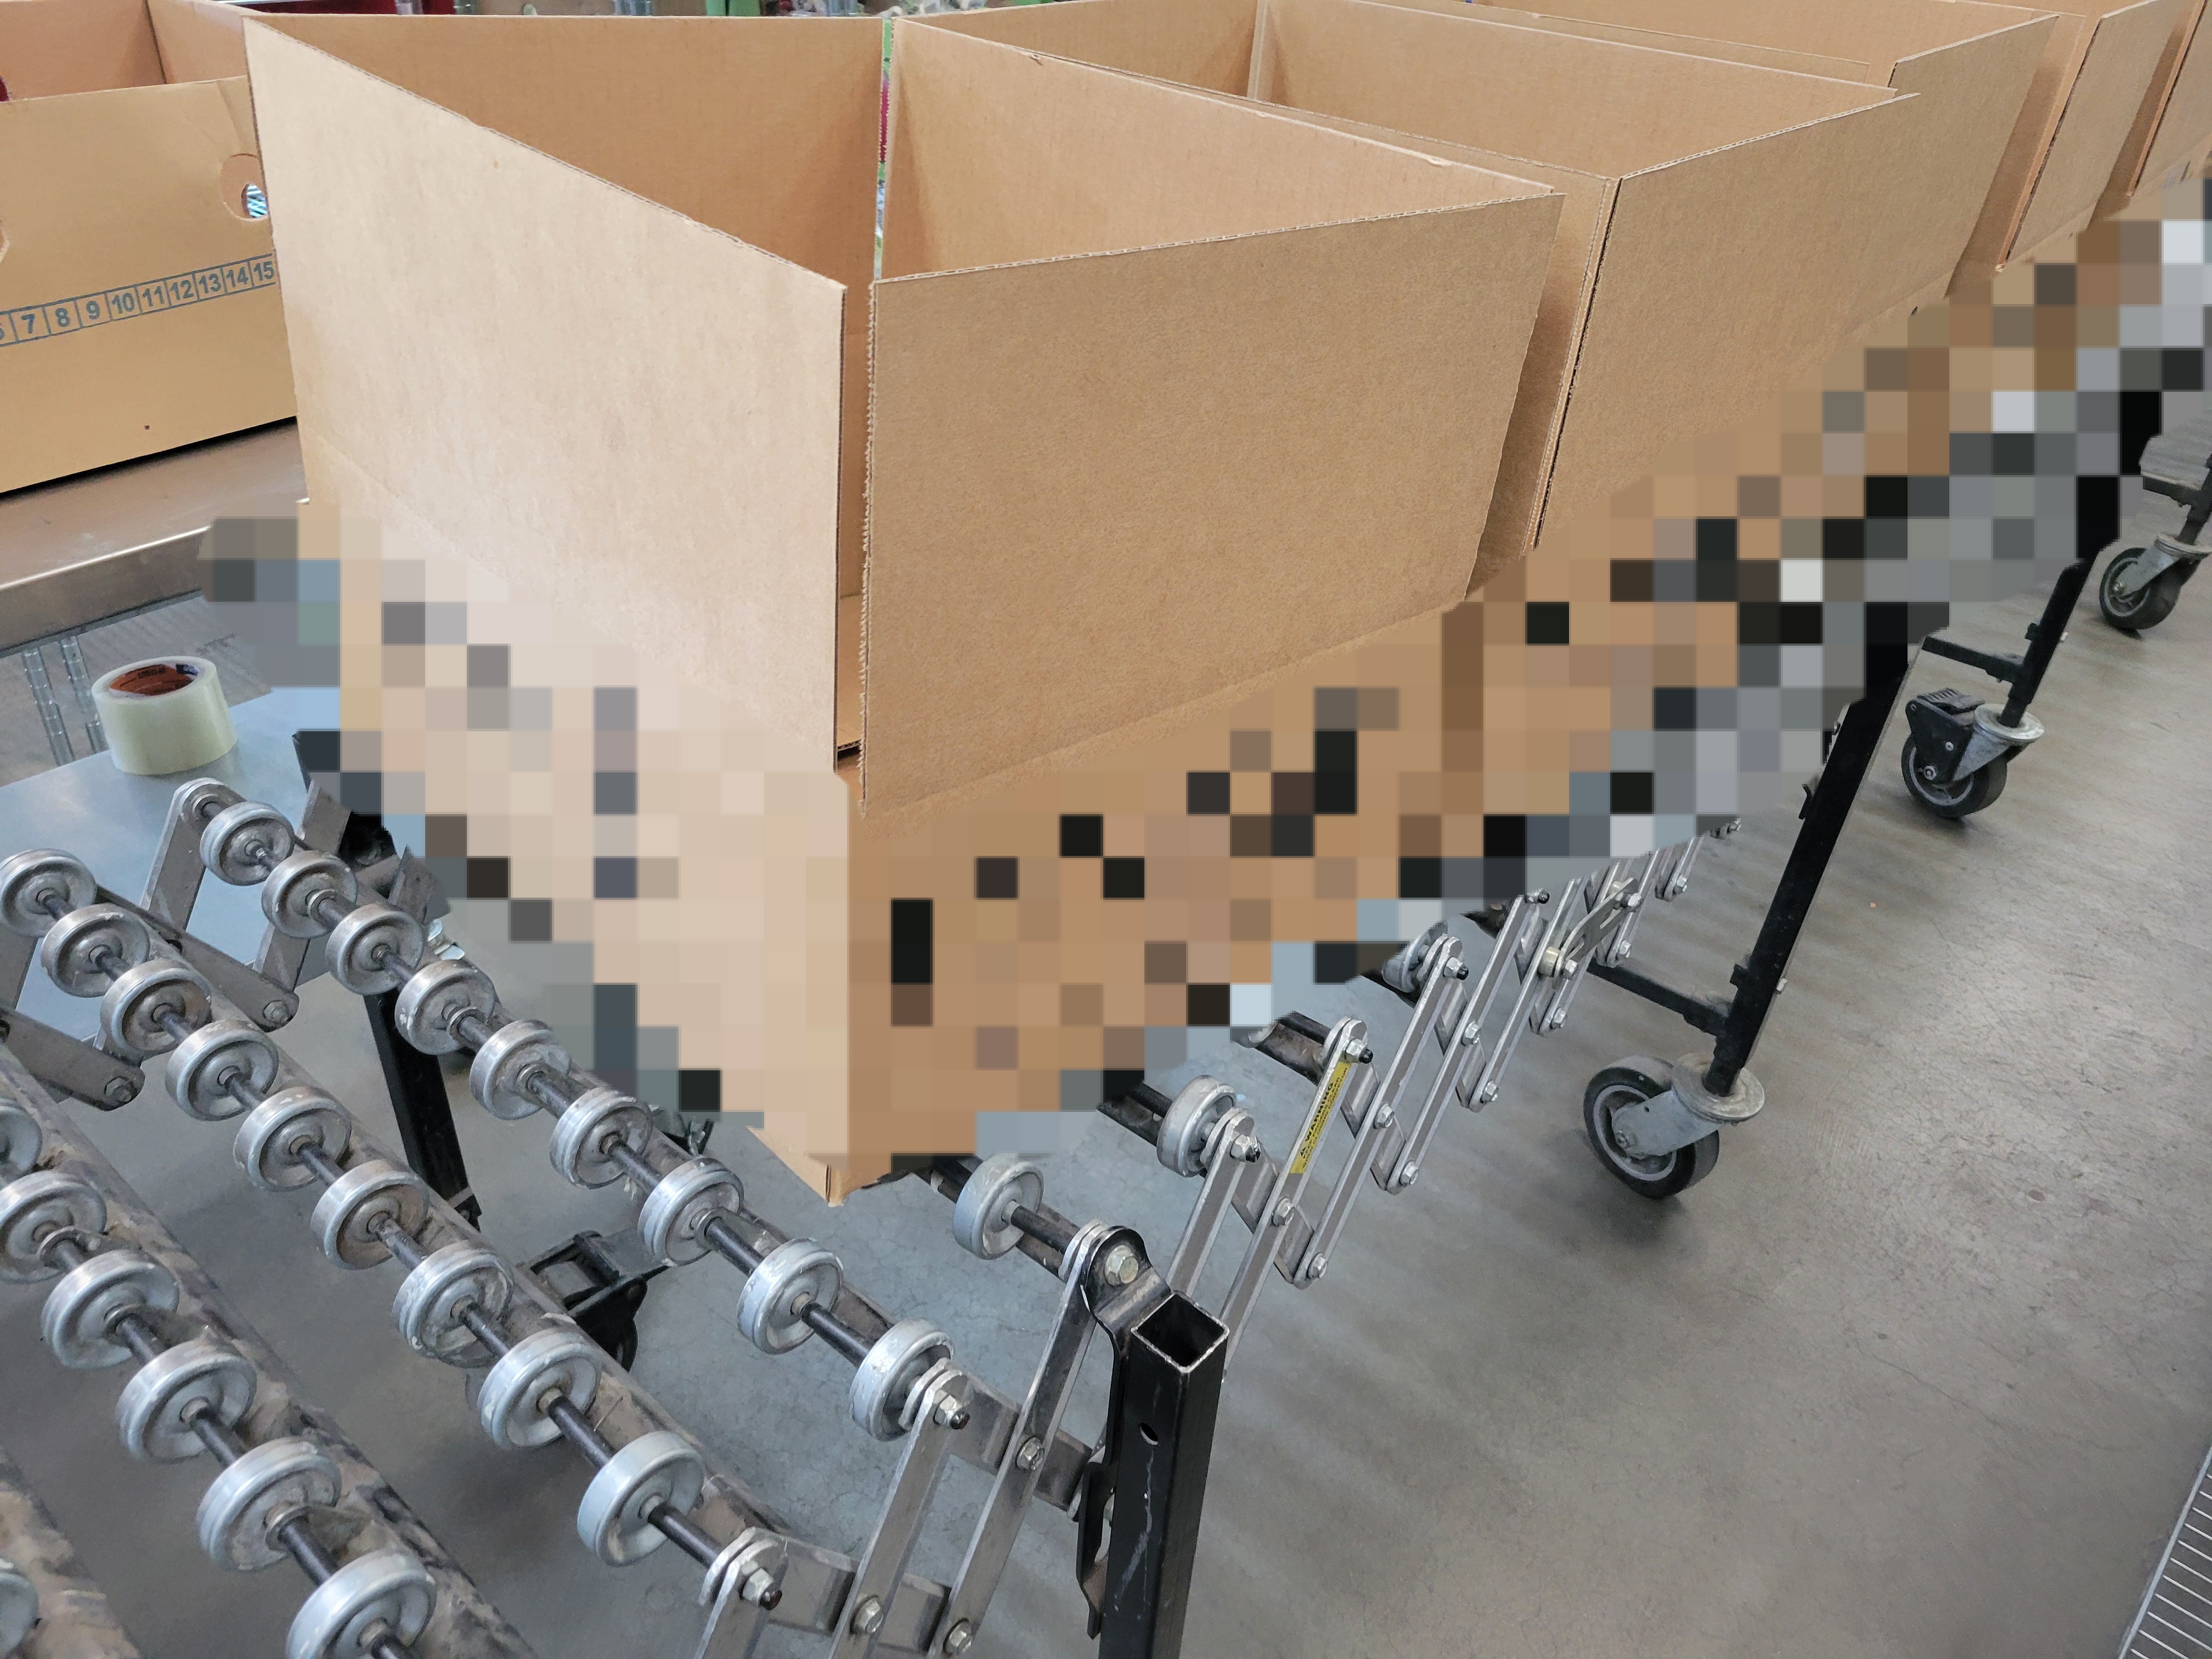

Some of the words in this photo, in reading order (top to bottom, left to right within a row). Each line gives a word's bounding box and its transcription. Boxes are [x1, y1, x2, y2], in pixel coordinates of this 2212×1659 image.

[21, 314, 35, 334] 7
[55, 308, 70, 327] 8
[86, 301, 100, 320] 9
[111, 292, 135, 314] 10
[142, 285, 165, 307] 11
[170, 280, 194, 301] 12
[199, 273, 221, 294] 13
[226, 267, 249, 287] 14
[253, 261, 274, 281] 15
[1304, 1082, 1334, 1141] WARNING
